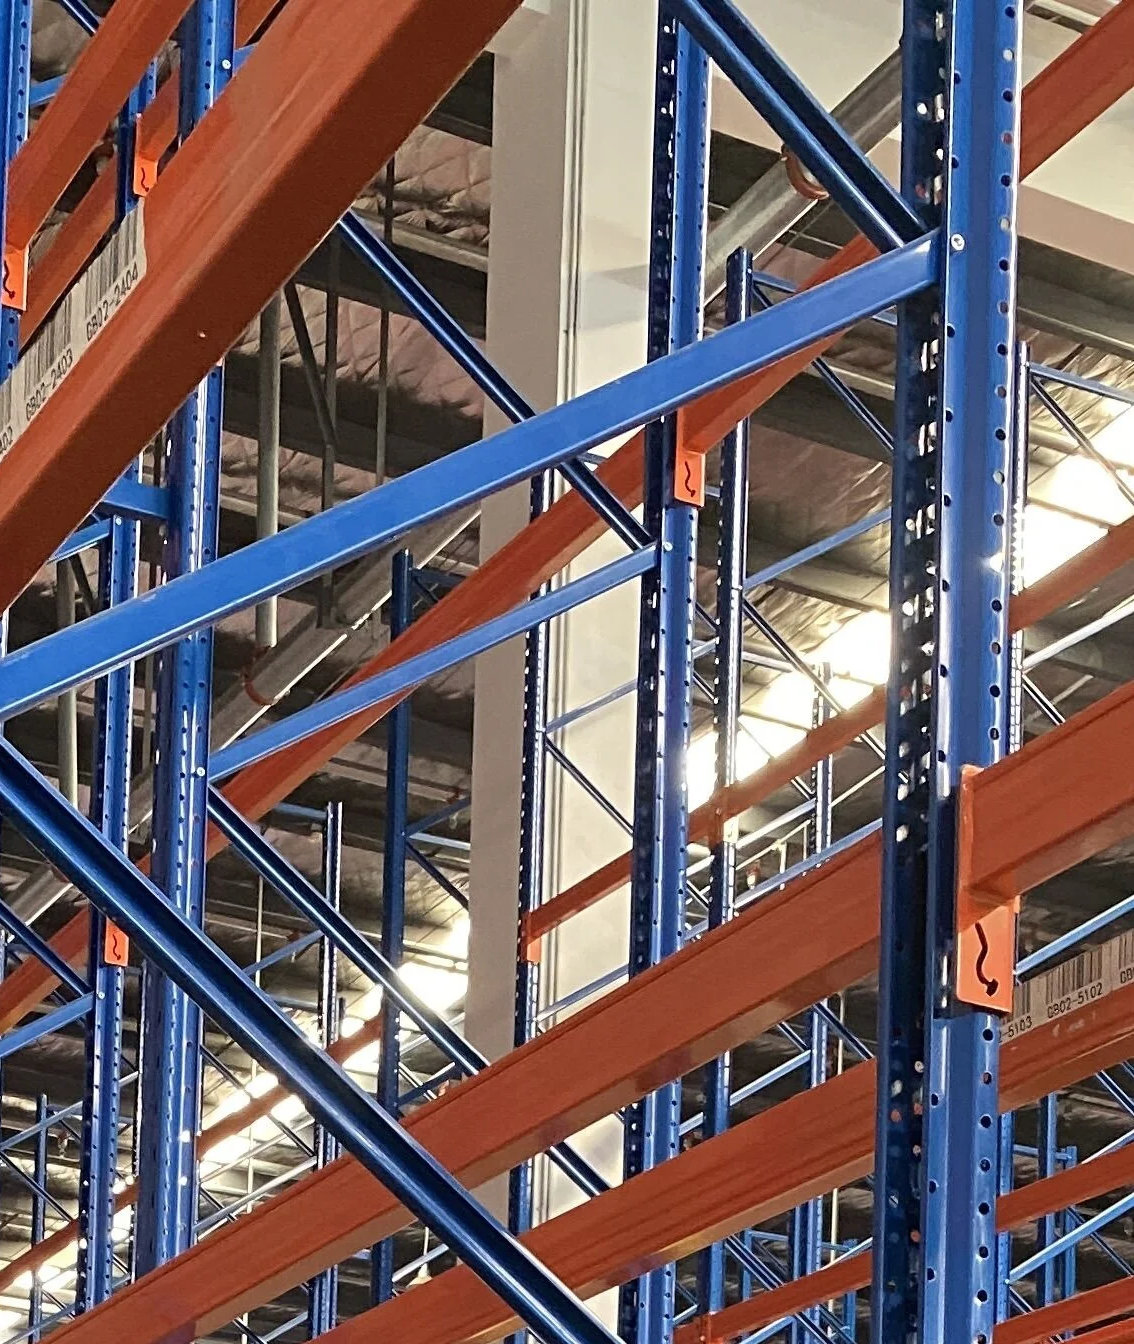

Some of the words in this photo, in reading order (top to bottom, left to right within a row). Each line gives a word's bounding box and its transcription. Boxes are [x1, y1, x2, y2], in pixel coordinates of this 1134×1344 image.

[26, 348, 73, 421] GB02-2403
[86, 261, 139, 341] GB02-2404
[1046, 982, 1103, 1019] GB02-5102
